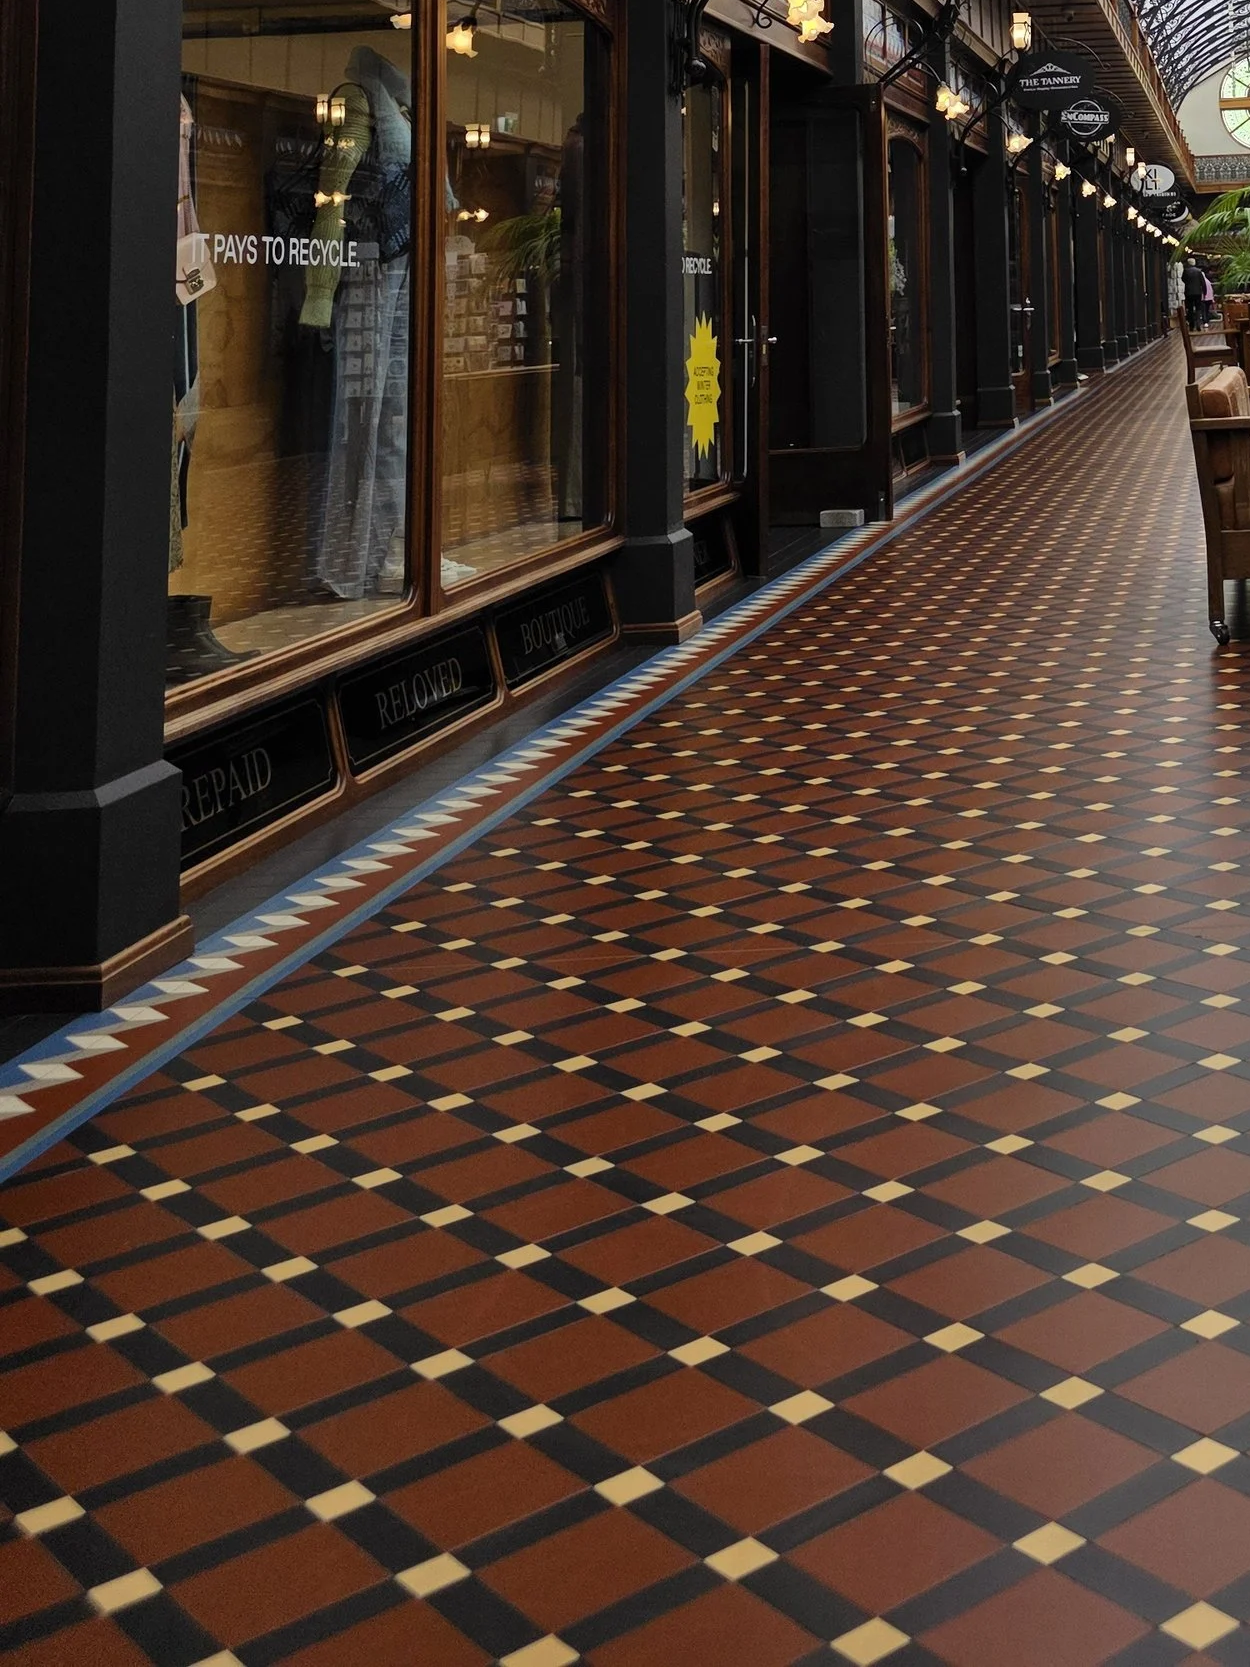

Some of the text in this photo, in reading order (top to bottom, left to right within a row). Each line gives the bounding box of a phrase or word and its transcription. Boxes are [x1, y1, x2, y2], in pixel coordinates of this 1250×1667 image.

[1019, 75, 1082, 88] THE TANNERY
[191, 233, 361, 268] IT PAYS TO RECYCLE.
[520, 596, 590, 655] BOUTIQUE
[374, 657, 463, 731] RELOVED
[180, 747, 273, 832] REPAID
